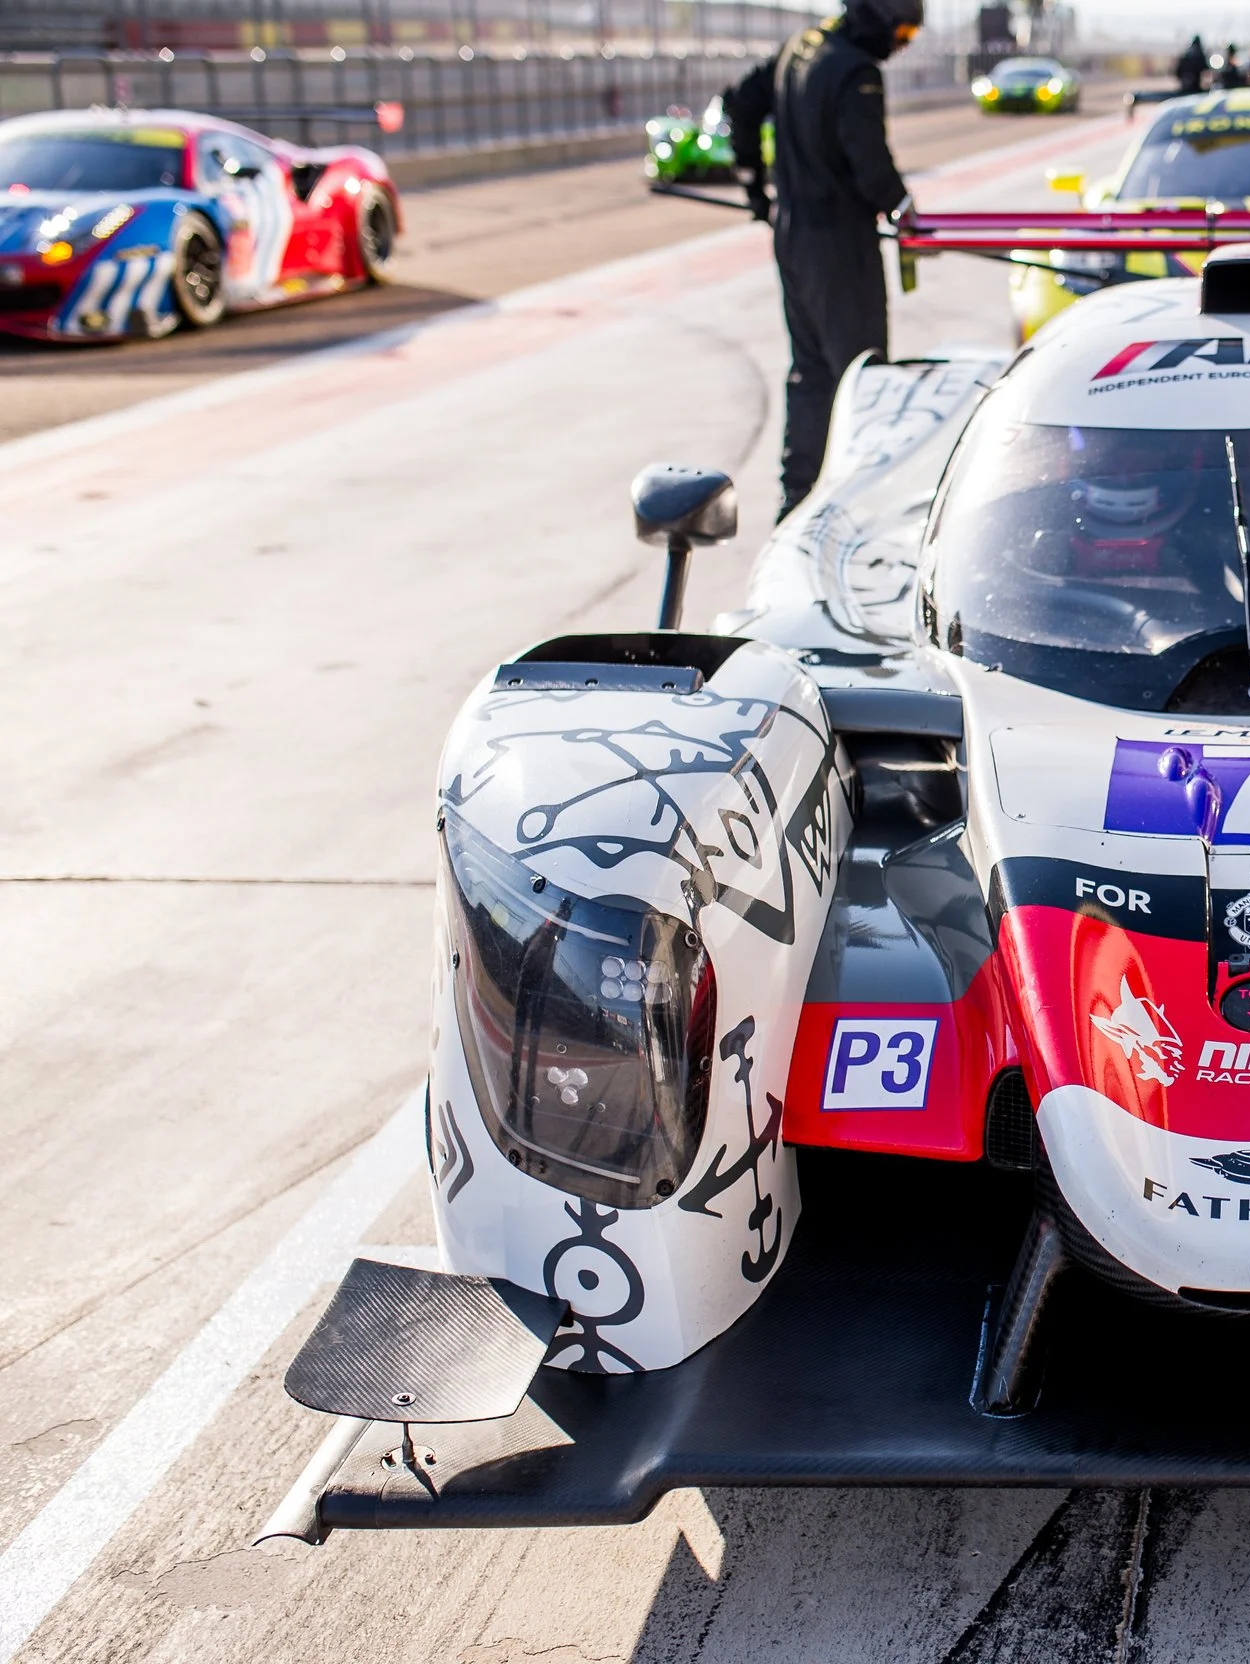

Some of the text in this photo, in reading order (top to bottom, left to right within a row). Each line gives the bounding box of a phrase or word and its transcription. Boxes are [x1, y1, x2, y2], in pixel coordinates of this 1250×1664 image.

[1088, 372, 1203, 396] INDEPENDENT
[1075, 877, 1152, 914] FOR
[831, 1031, 925, 1094] P3
